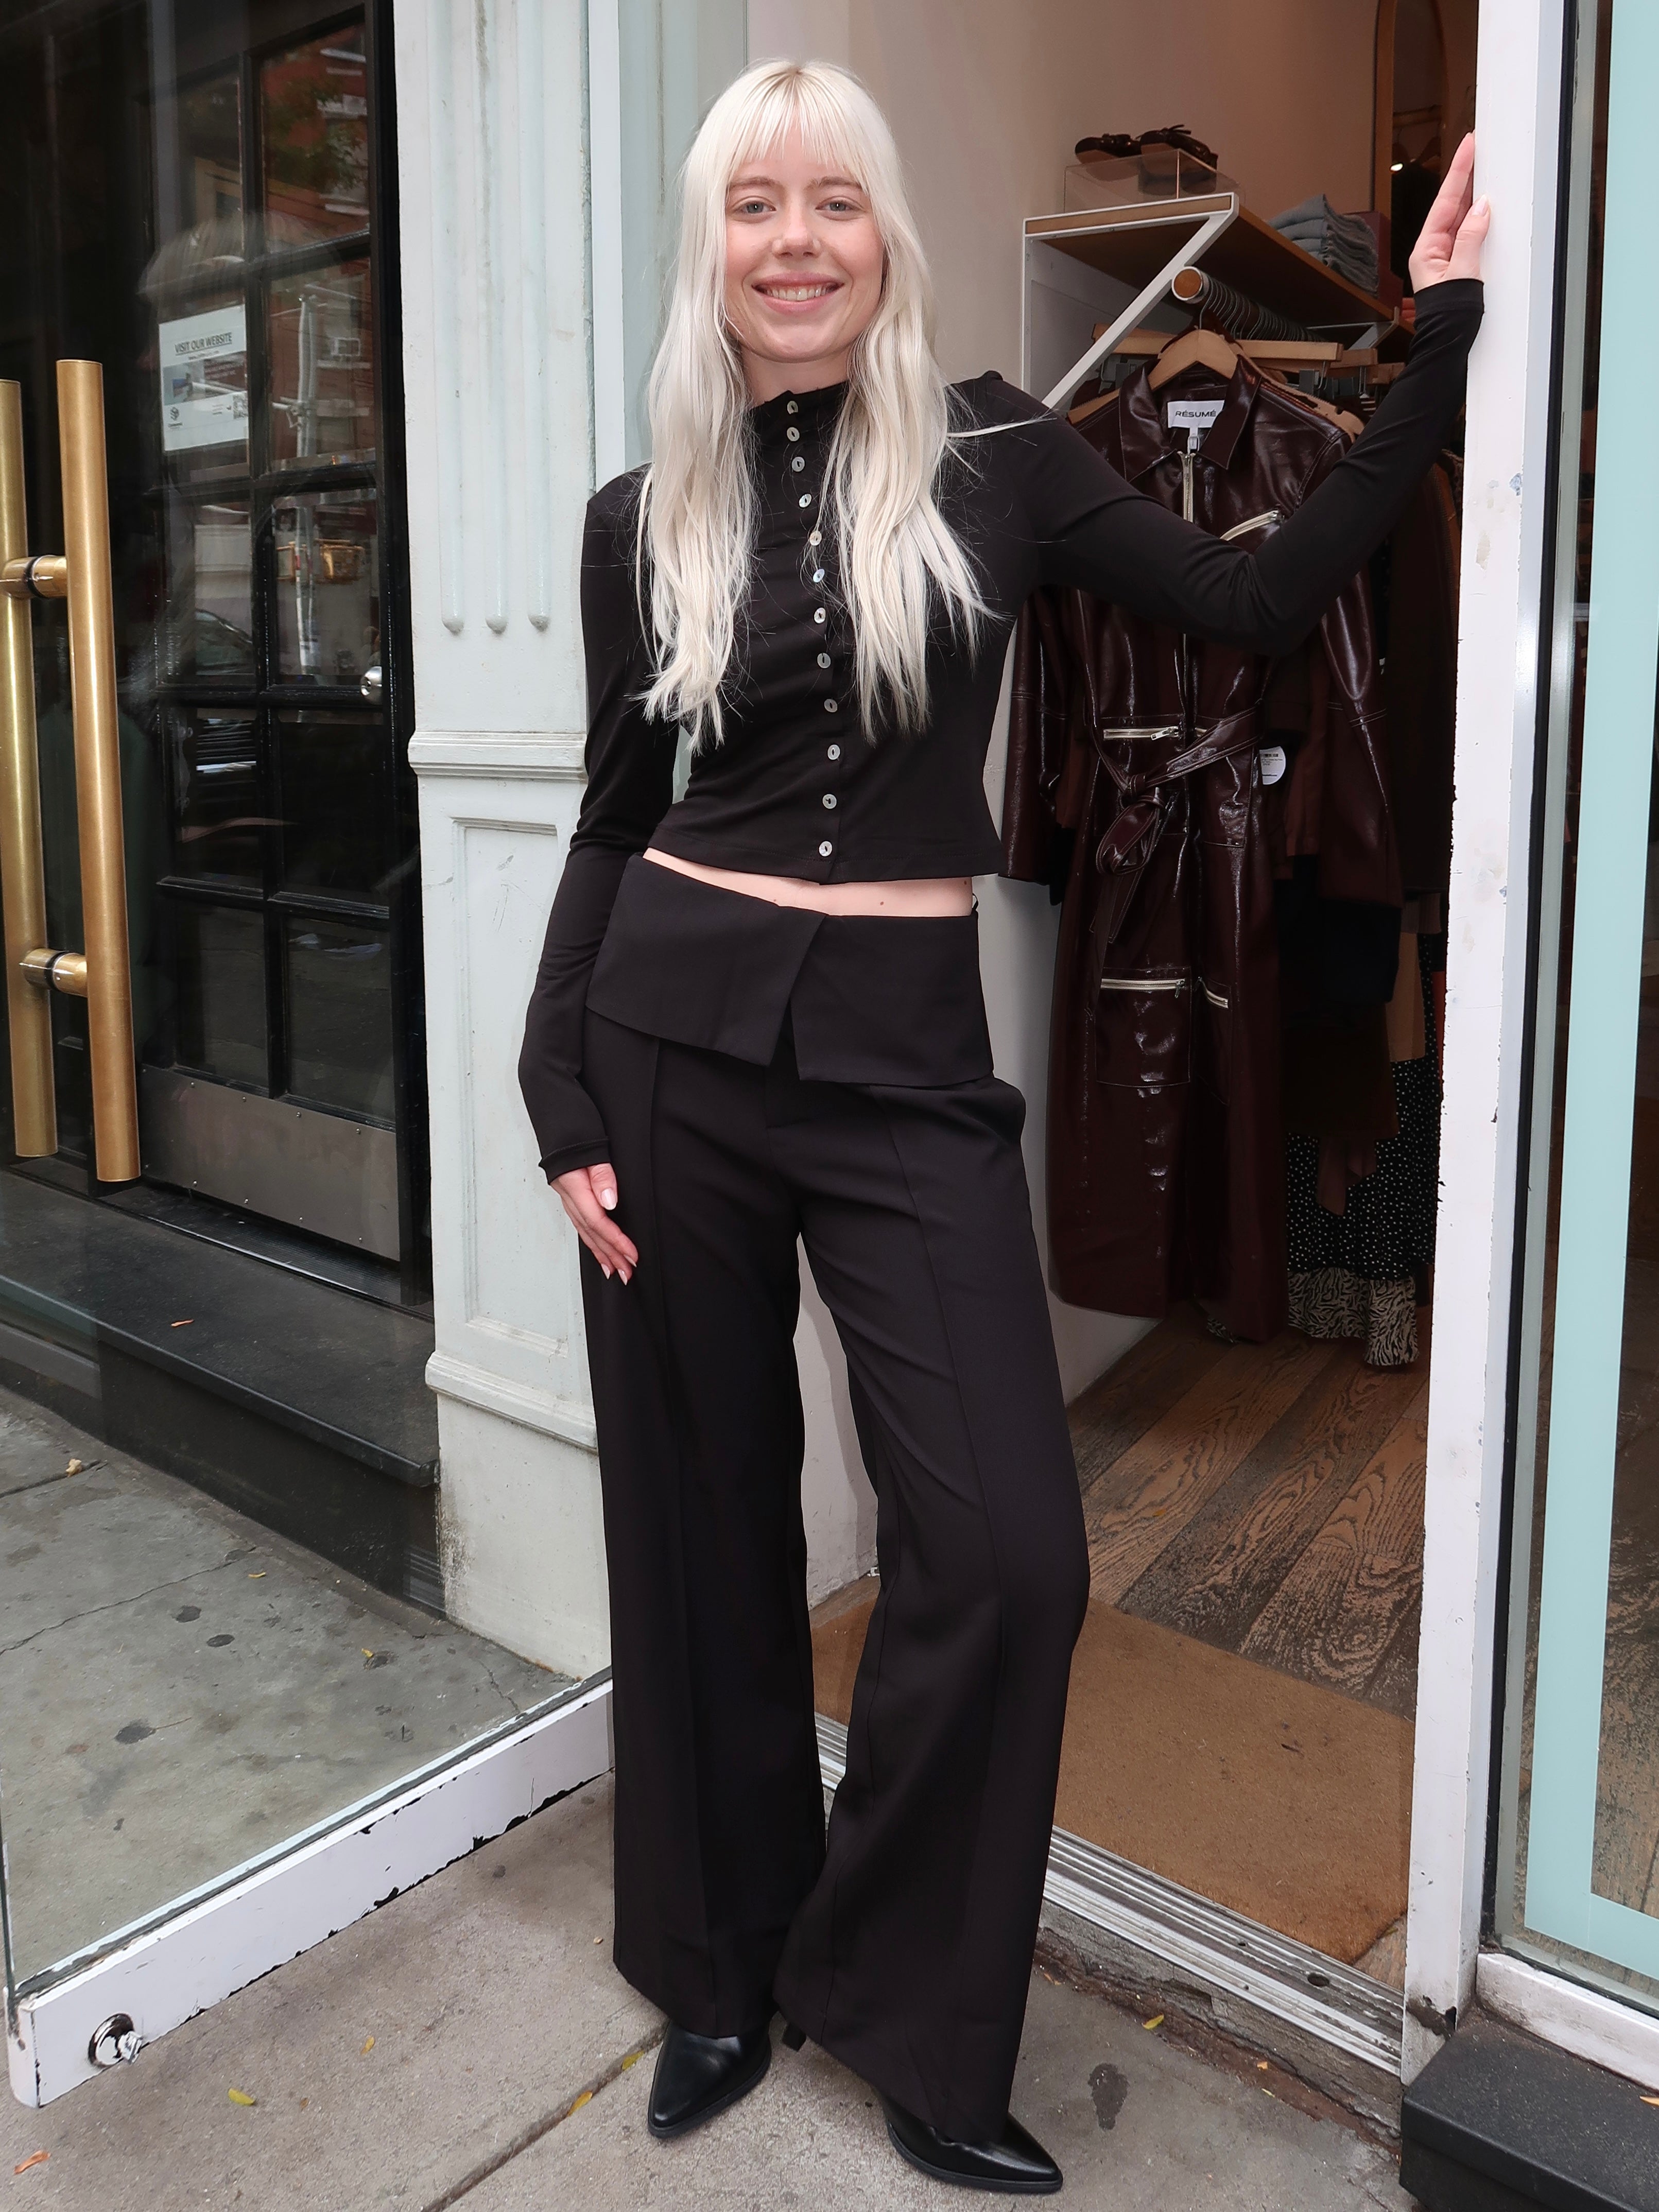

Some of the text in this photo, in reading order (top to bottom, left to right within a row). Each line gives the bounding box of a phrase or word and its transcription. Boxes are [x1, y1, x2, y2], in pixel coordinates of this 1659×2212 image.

[175, 332, 232, 353] VISIT OUR WEBSITE
[1175, 409, 1216, 418] RÉSUMÉ
